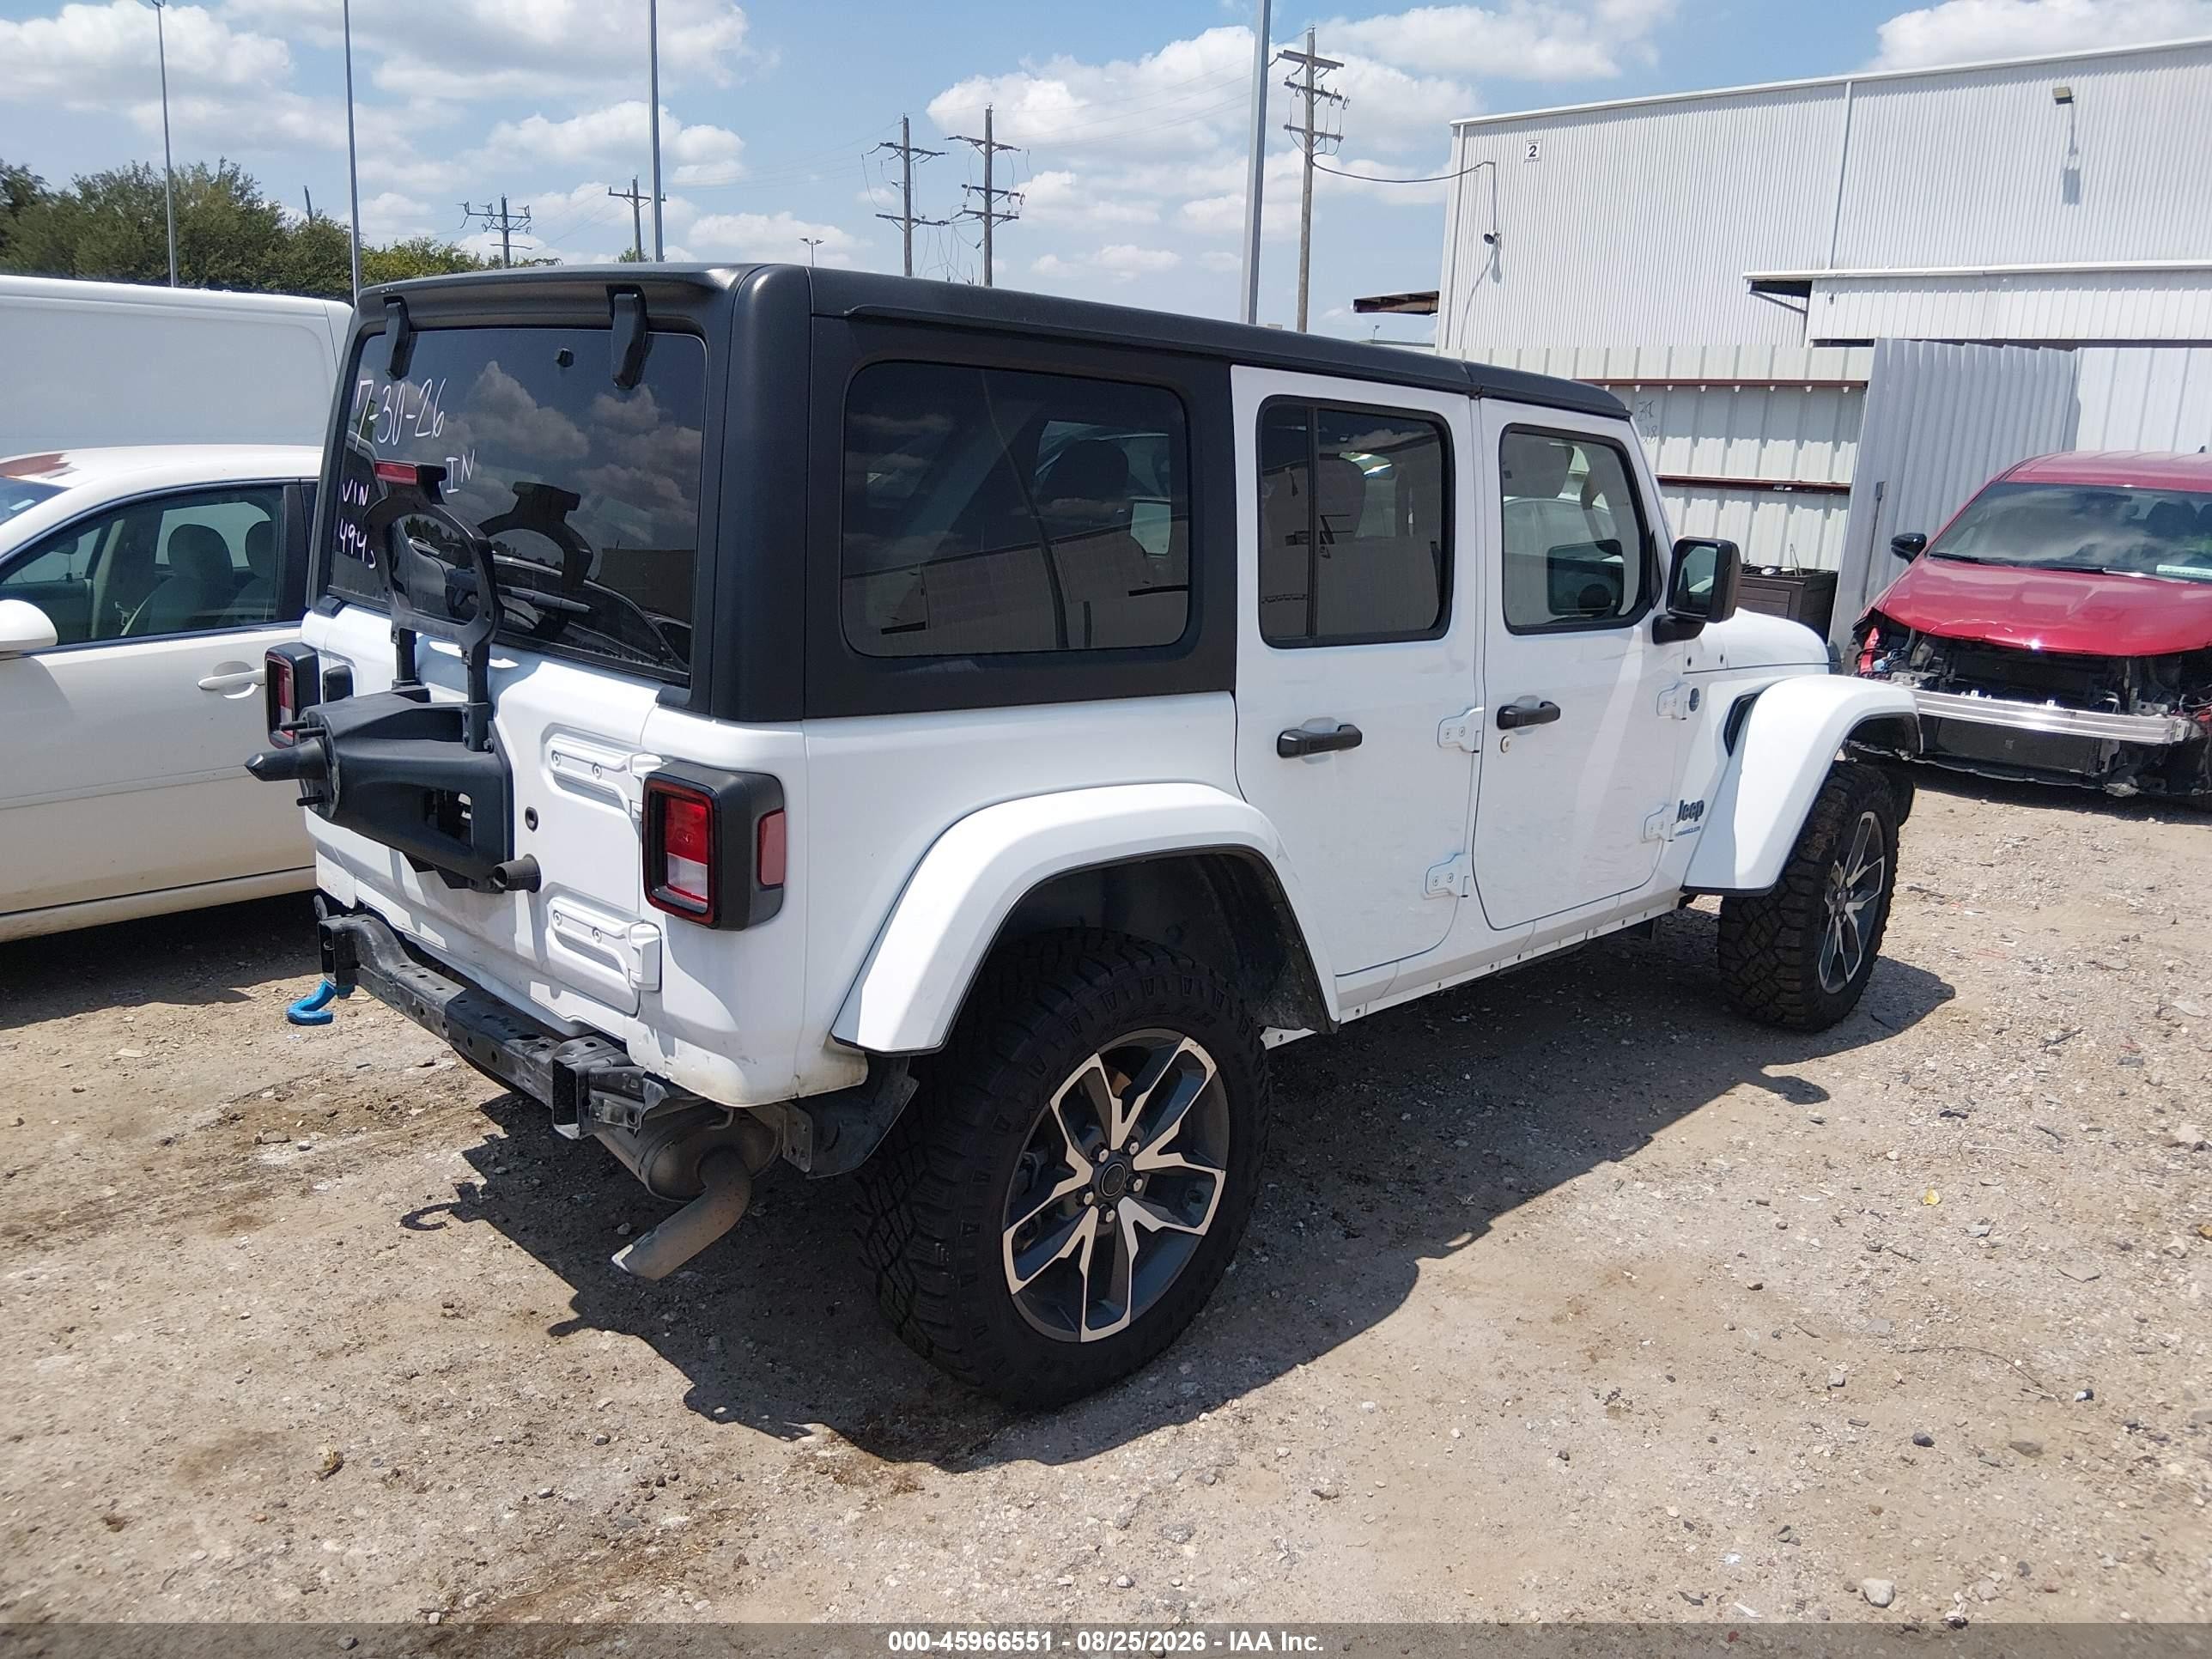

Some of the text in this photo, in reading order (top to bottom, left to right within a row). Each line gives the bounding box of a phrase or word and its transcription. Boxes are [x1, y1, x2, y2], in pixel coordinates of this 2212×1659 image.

[1528, 145, 1538, 158] 2
[355, 378, 447, 452] 7-30-26
[445, 449, 476, 494] IN
[342, 478, 370, 507] VIN
[1676, 799, 1705, 823] Jeep
